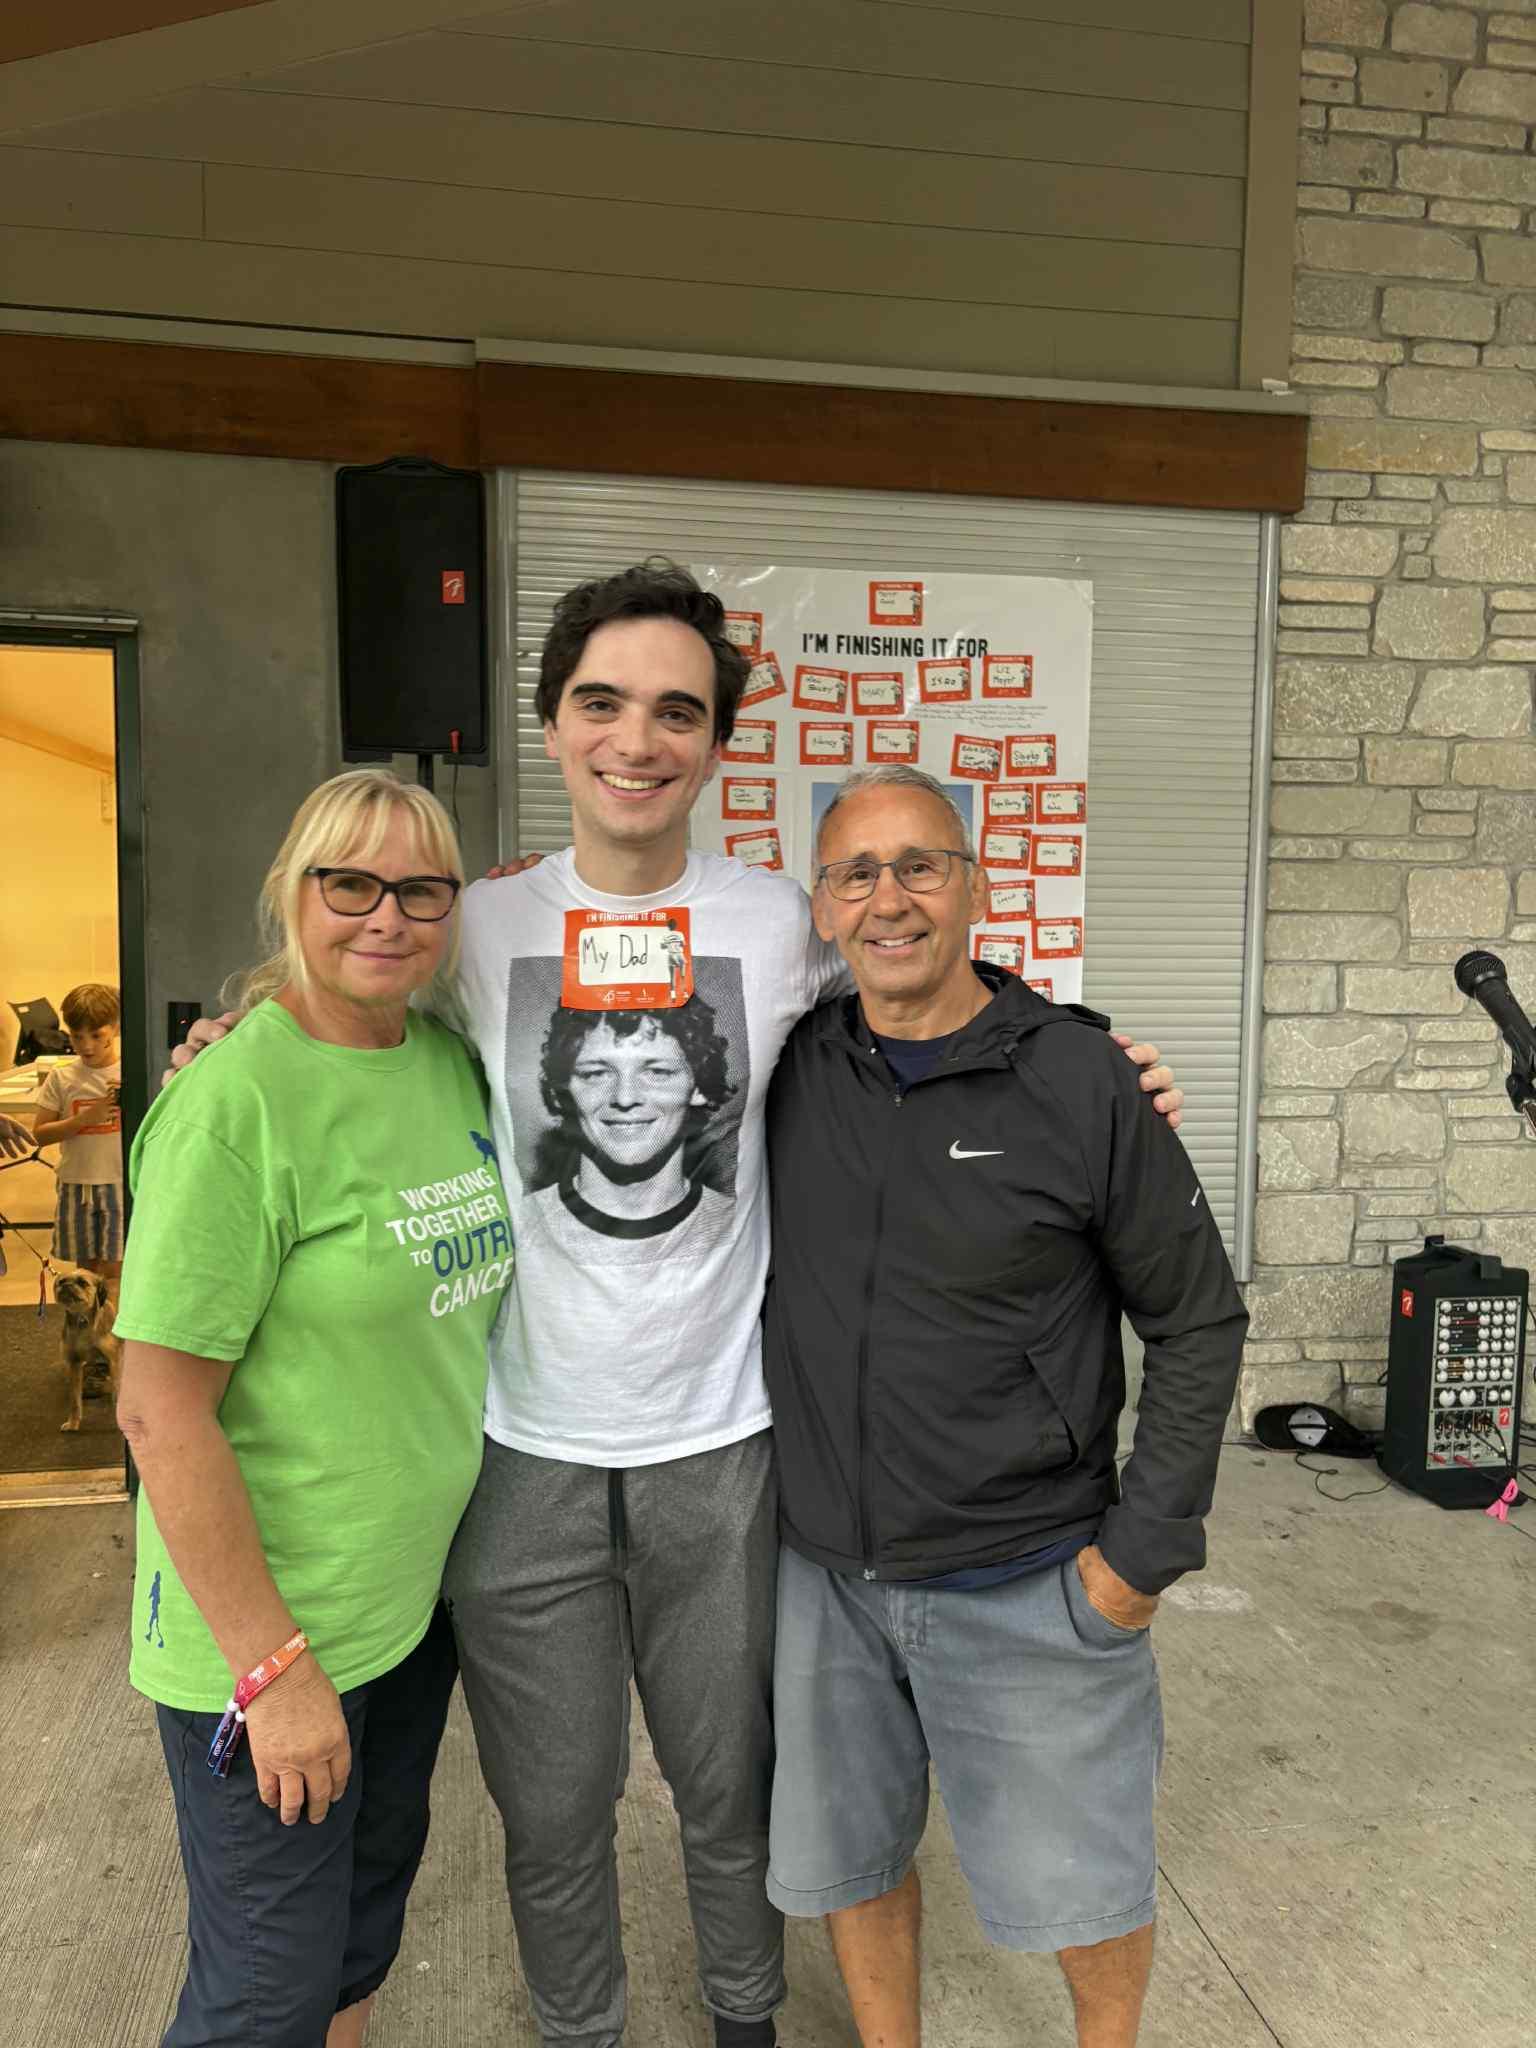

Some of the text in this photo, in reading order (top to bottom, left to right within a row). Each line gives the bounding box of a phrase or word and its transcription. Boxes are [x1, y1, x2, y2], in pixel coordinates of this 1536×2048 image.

[803, 633, 988, 658] I'M FINISHING IT FOR
[651, 911, 667, 921] FOR
[582, 933, 649, 973] My Dad
[397, 1167, 496, 1212] WORKING
[384, 1193, 503, 1245] TOGETHER
[409, 1216, 515, 1278] TO OUTR
[429, 1256, 515, 1318] CANCE
